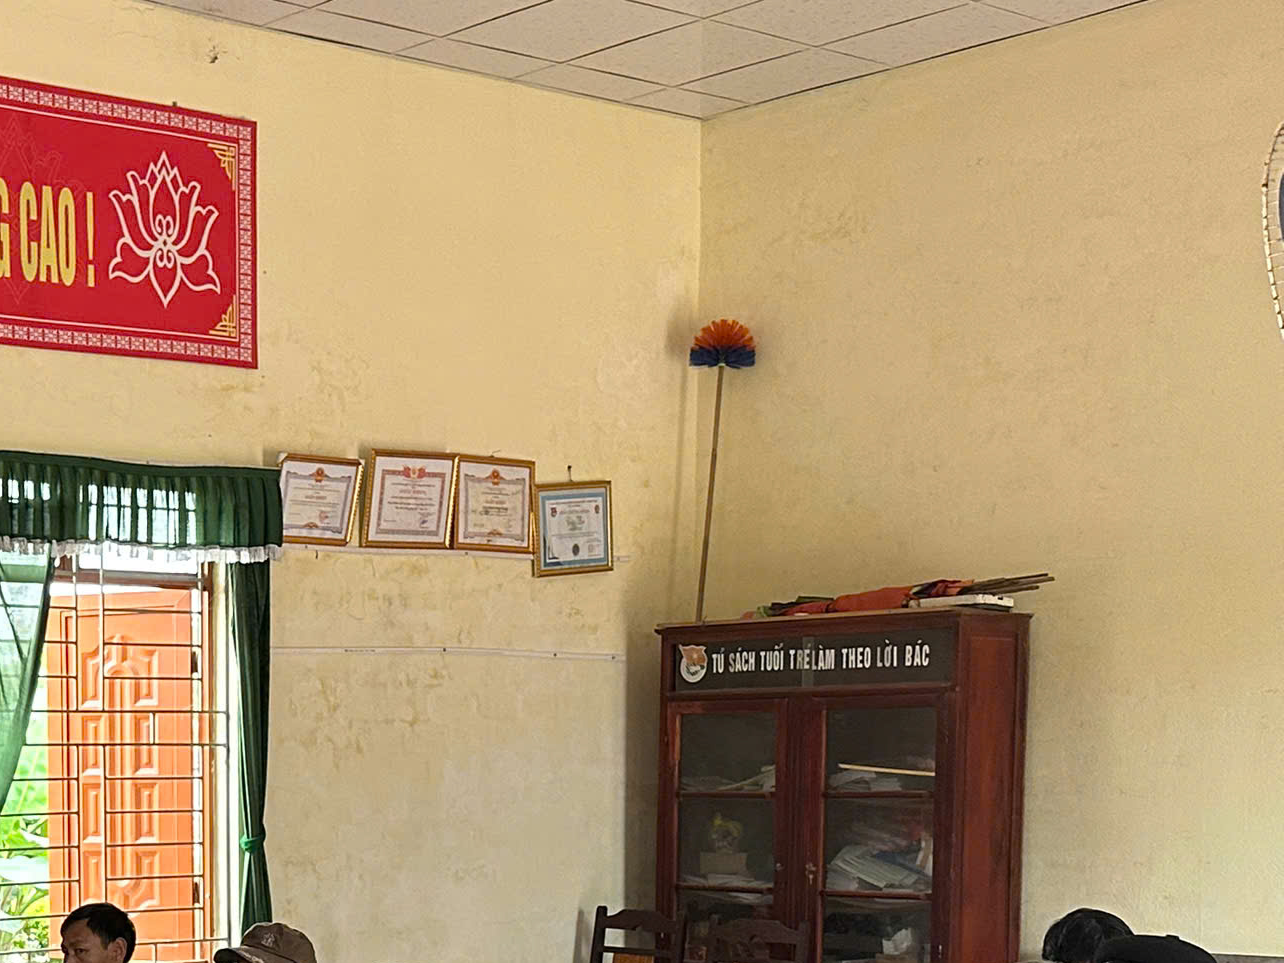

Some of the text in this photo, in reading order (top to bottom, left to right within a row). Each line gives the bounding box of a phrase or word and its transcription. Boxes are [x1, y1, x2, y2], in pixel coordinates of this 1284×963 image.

[20, 184, 77, 286] CAO
[728, 648, 756, 673] SÁCH
[811, 645, 836, 671] LÀM
[841, 647, 872, 669] THEO
[876, 640, 898, 668] LỜI
[904, 640, 930, 667] BÁC
